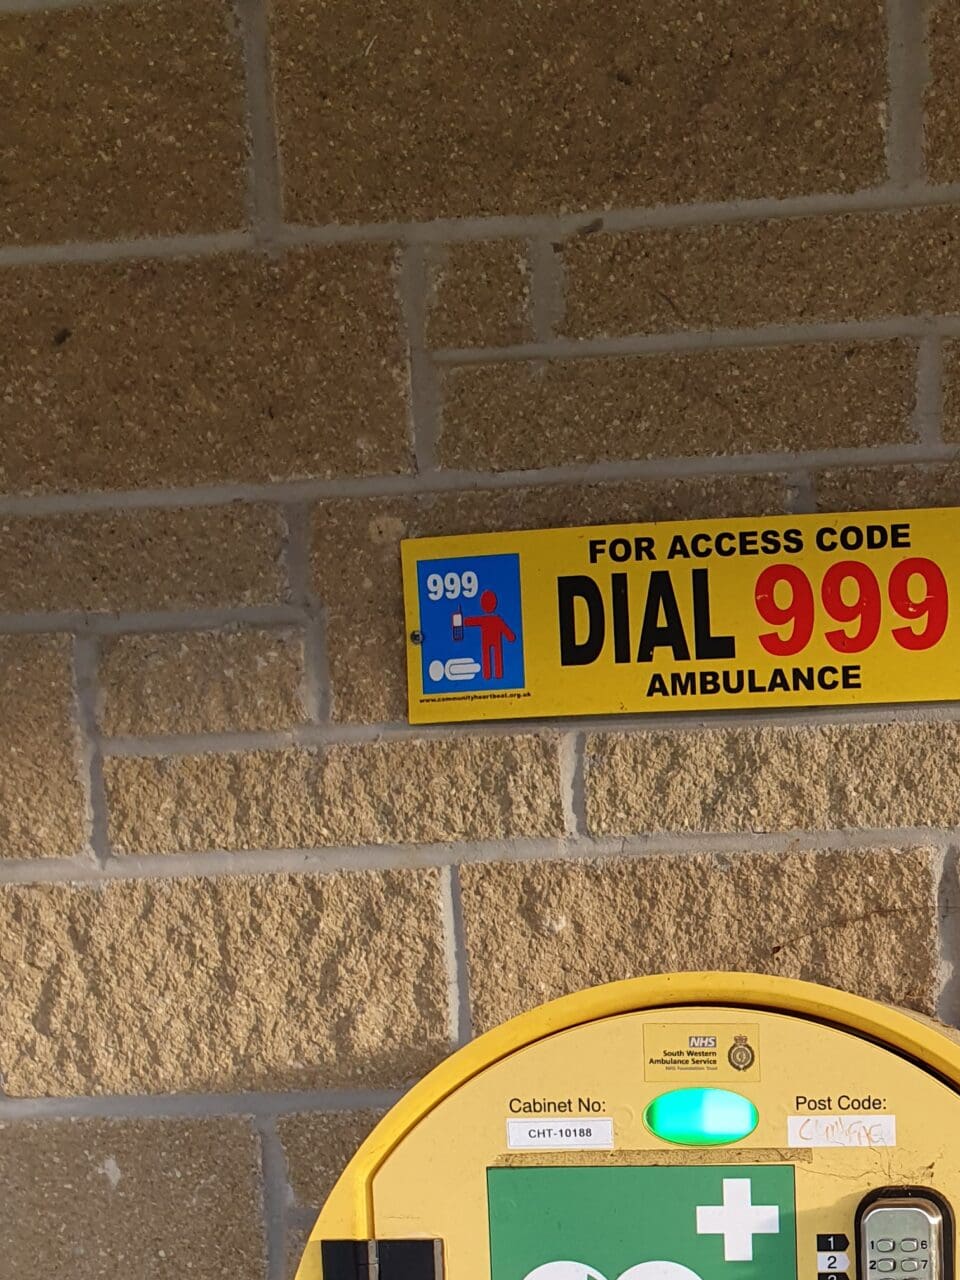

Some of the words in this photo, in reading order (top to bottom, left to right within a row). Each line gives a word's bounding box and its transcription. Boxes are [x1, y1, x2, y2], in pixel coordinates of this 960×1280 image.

[588, 535, 657, 564] FOR
[667, 528, 804, 560] ACCESS
[815, 523, 912, 552] CODE
[425, 570, 480, 601] 999
[557, 567, 737, 667] DIAL
[753, 556, 950, 657] 999
[645, 664, 863, 698] AMBULANCE
[419, 691, 532, 704] www.communityheartbeat.org.uk
[690, 1037, 716, 1047] NHS
[663, 1049, 685, 1057] South
[686, 1049, 717, 1057] Western
[509, 1097, 573, 1113] Cabinet
[578, 1097, 606, 1113] No:
[795, 1095, 836, 1111] Post
[837, 1095, 887, 1111] Code:
[528, 1127, 593, 1139] CHT-10188
[827, 1236, 835, 1250] 1
[870, 1240, 875, 1250] 1
[920, 1240, 928, 1250] 6
[826, 1255, 838, 1269] 2
[869, 1260, 877, 1270] 2
[920, 1260, 929, 1270] 7
